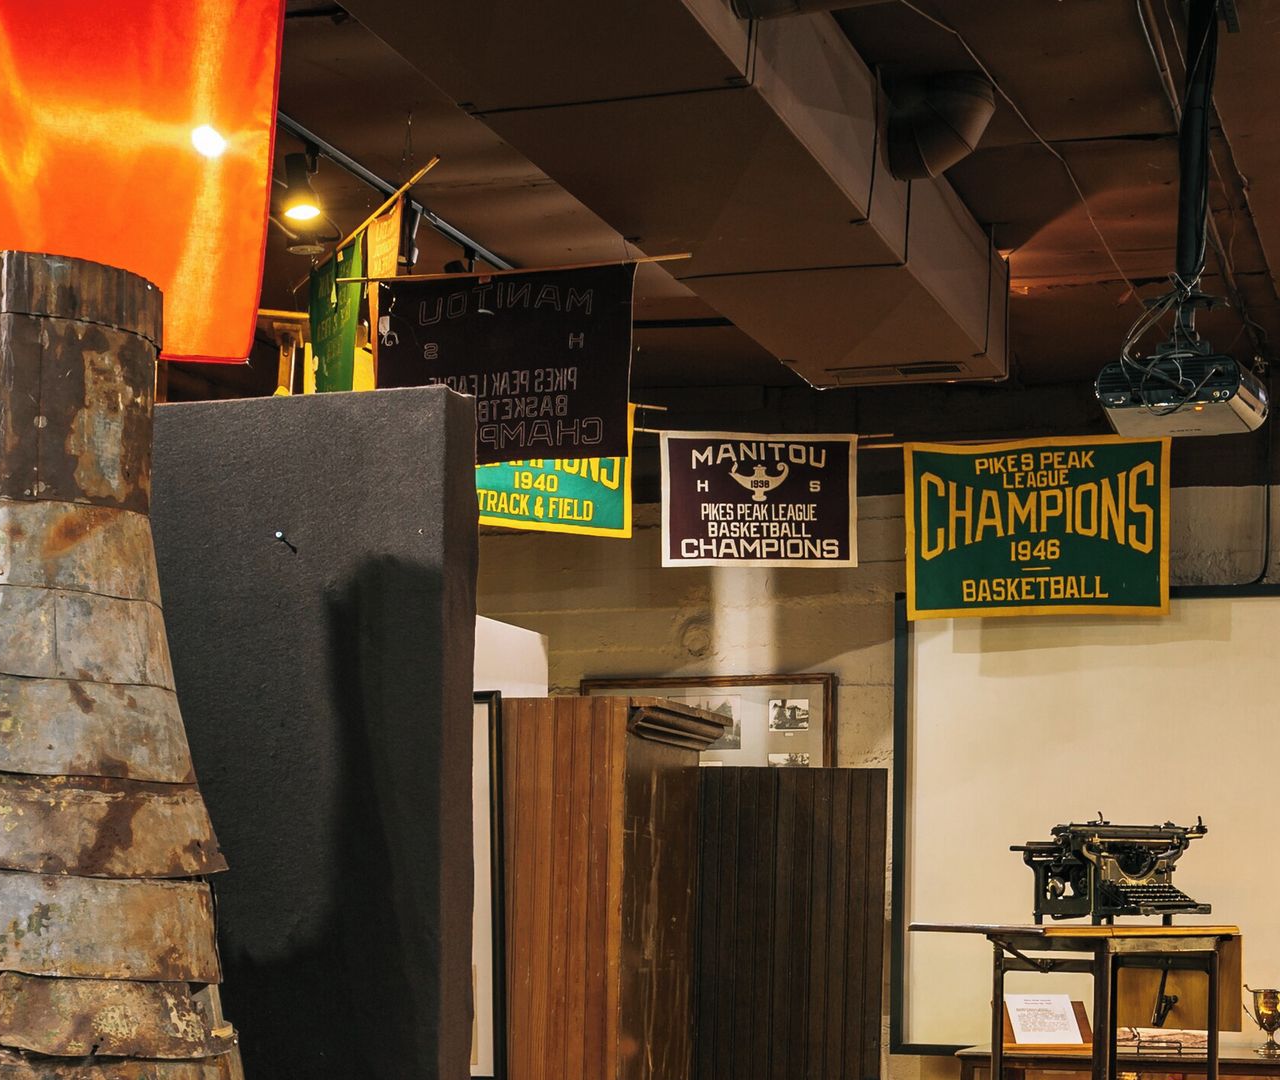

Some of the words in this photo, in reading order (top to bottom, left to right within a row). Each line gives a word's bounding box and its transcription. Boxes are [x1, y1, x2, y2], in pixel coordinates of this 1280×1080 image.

[691, 442, 826, 469] MANITOU
[974, 453, 1034, 475] PIKES
[1040, 450, 1095, 470] PEAK
[514, 471, 558, 493] 1940
[697, 480, 709, 492] H
[809, 480, 821, 492] S
[1003, 468, 1069, 489] LEAGUE
[477, 489, 530, 516] TRACK
[534, 496, 544, 519] &
[548, 497, 593, 521] FIELD
[701, 503, 734, 521] PIKES
[737, 503, 769, 521] PEAK
[771, 503, 817, 521] LEAGUE
[920, 460, 1155, 561] CHAMPIONS
[708, 522, 811, 538] BASKETBALL
[681, 538, 839, 559] CHAMPIONS
[1010, 539, 1060, 562] 1946
[962, 575, 1109, 602] BASKETBALL
